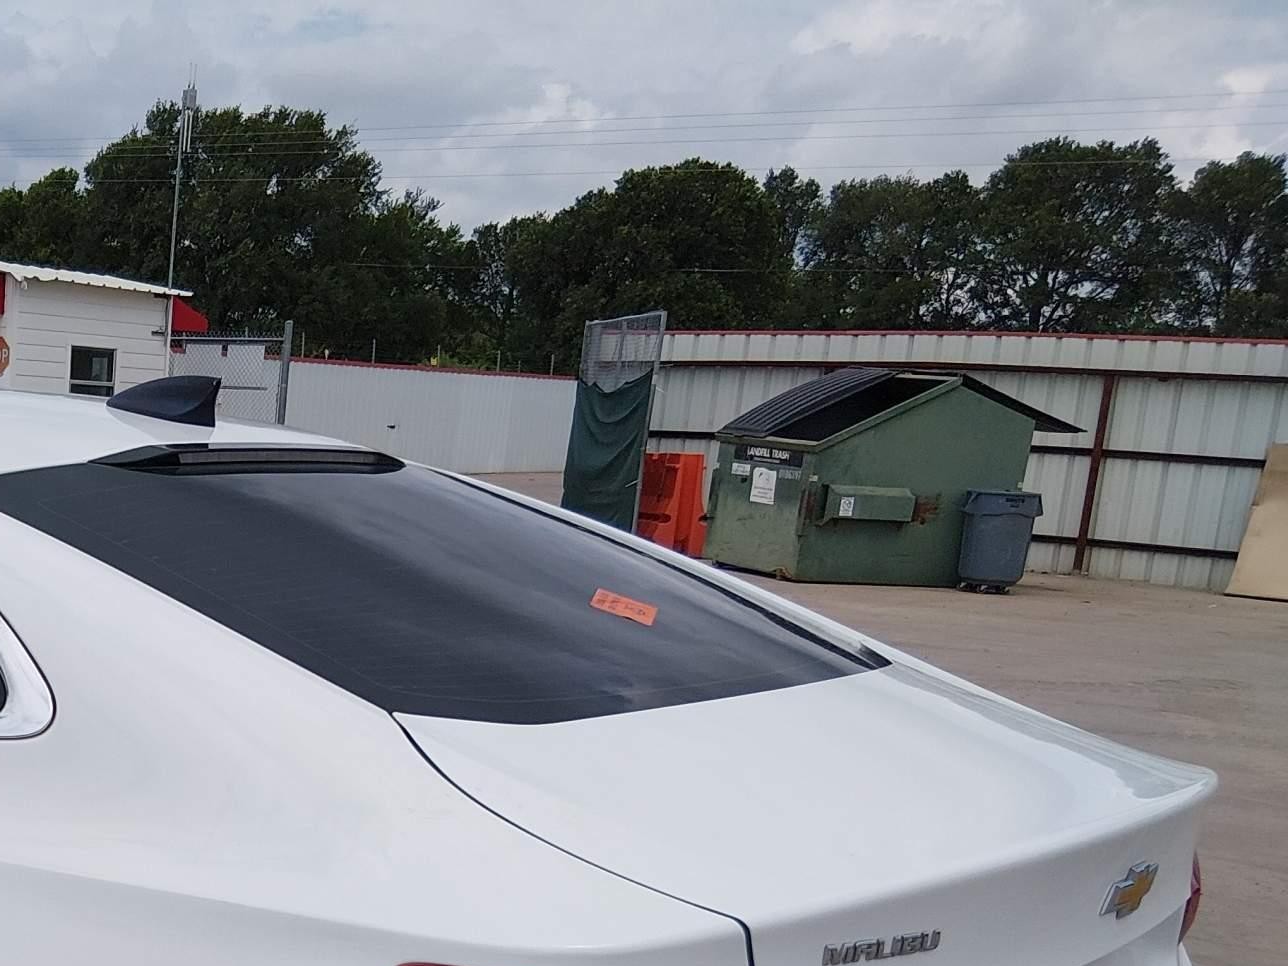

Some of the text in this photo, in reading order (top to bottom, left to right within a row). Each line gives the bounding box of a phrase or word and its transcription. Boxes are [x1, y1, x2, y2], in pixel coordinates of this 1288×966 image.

[746, 446, 770, 458] LANDFILL
[772, 449, 790, 460] TRASH
[822, 930, 941, 966] MALIBU
